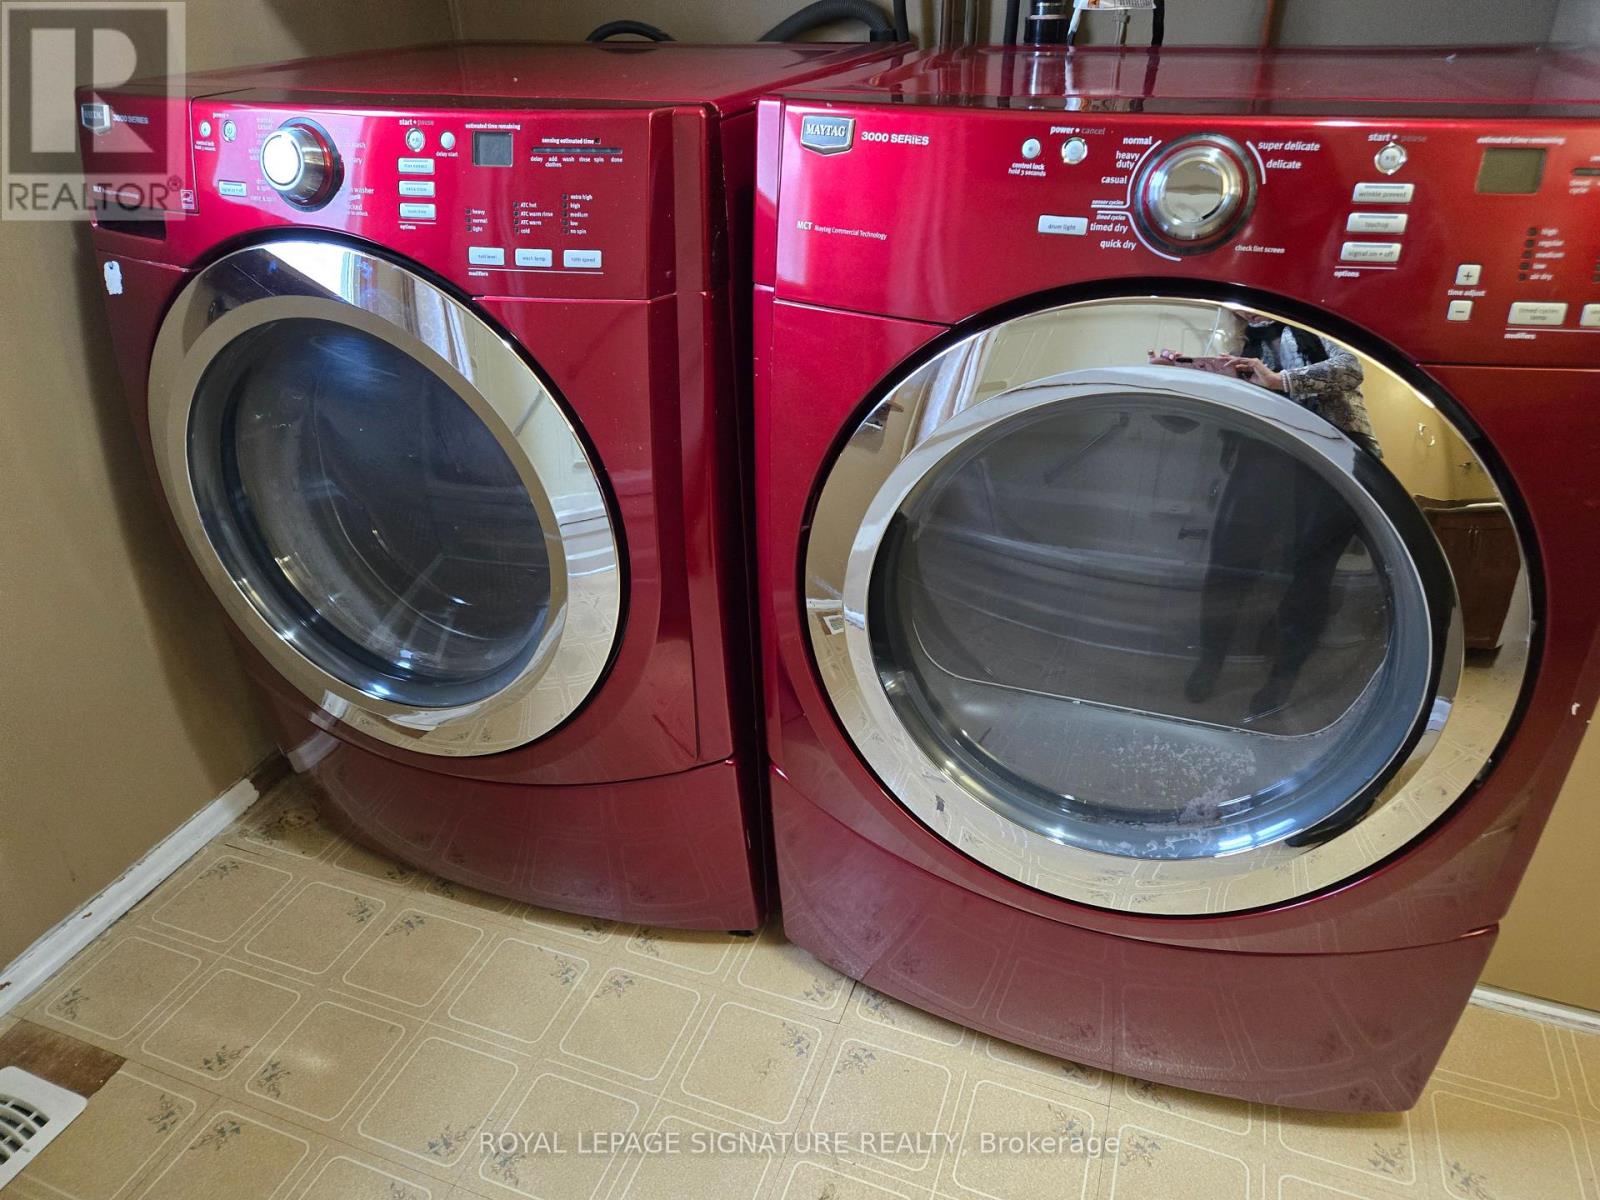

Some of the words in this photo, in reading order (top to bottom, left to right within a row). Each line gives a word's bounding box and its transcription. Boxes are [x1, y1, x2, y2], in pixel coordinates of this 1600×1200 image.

[806, 123, 846, 137] MAYTAG
[1050, 126, 1075, 136] power
[1081, 127, 1106, 135] cancel
[861, 131, 889, 143] 3000
[890, 133, 930, 146] SERIES
[1123, 136, 1153, 145] normal
[1368, 133, 1390, 142] start
[1257, 141, 1283, 152] super
[1284, 141, 1320, 152] delicate
[1116, 150, 1140, 161] heavy
[1012, 162, 1032, 170] control
[1116, 160, 1135, 171] duty
[1266, 159, 1302, 170] delicate
[1025, 169, 1046, 177] seconds
[1101, 176, 1128, 184] casual
[796, 220, 813, 230] MCT
[832, 226, 860, 237] Commercial
[859, 229, 887, 240] Technology
[1063, 223, 1076, 231] light
[1090, 222, 1113, 232] timed
[1114, 222, 1129, 234] dry
[1100, 239, 1121, 249] quick
[1122, 240, 1136, 251] dry
[1264, 246, 1285, 254] screen
[1334, 270, 1360, 278] options
[1447, 288, 1463, 296] time
[1464, 289, 1487, 297] adjust
